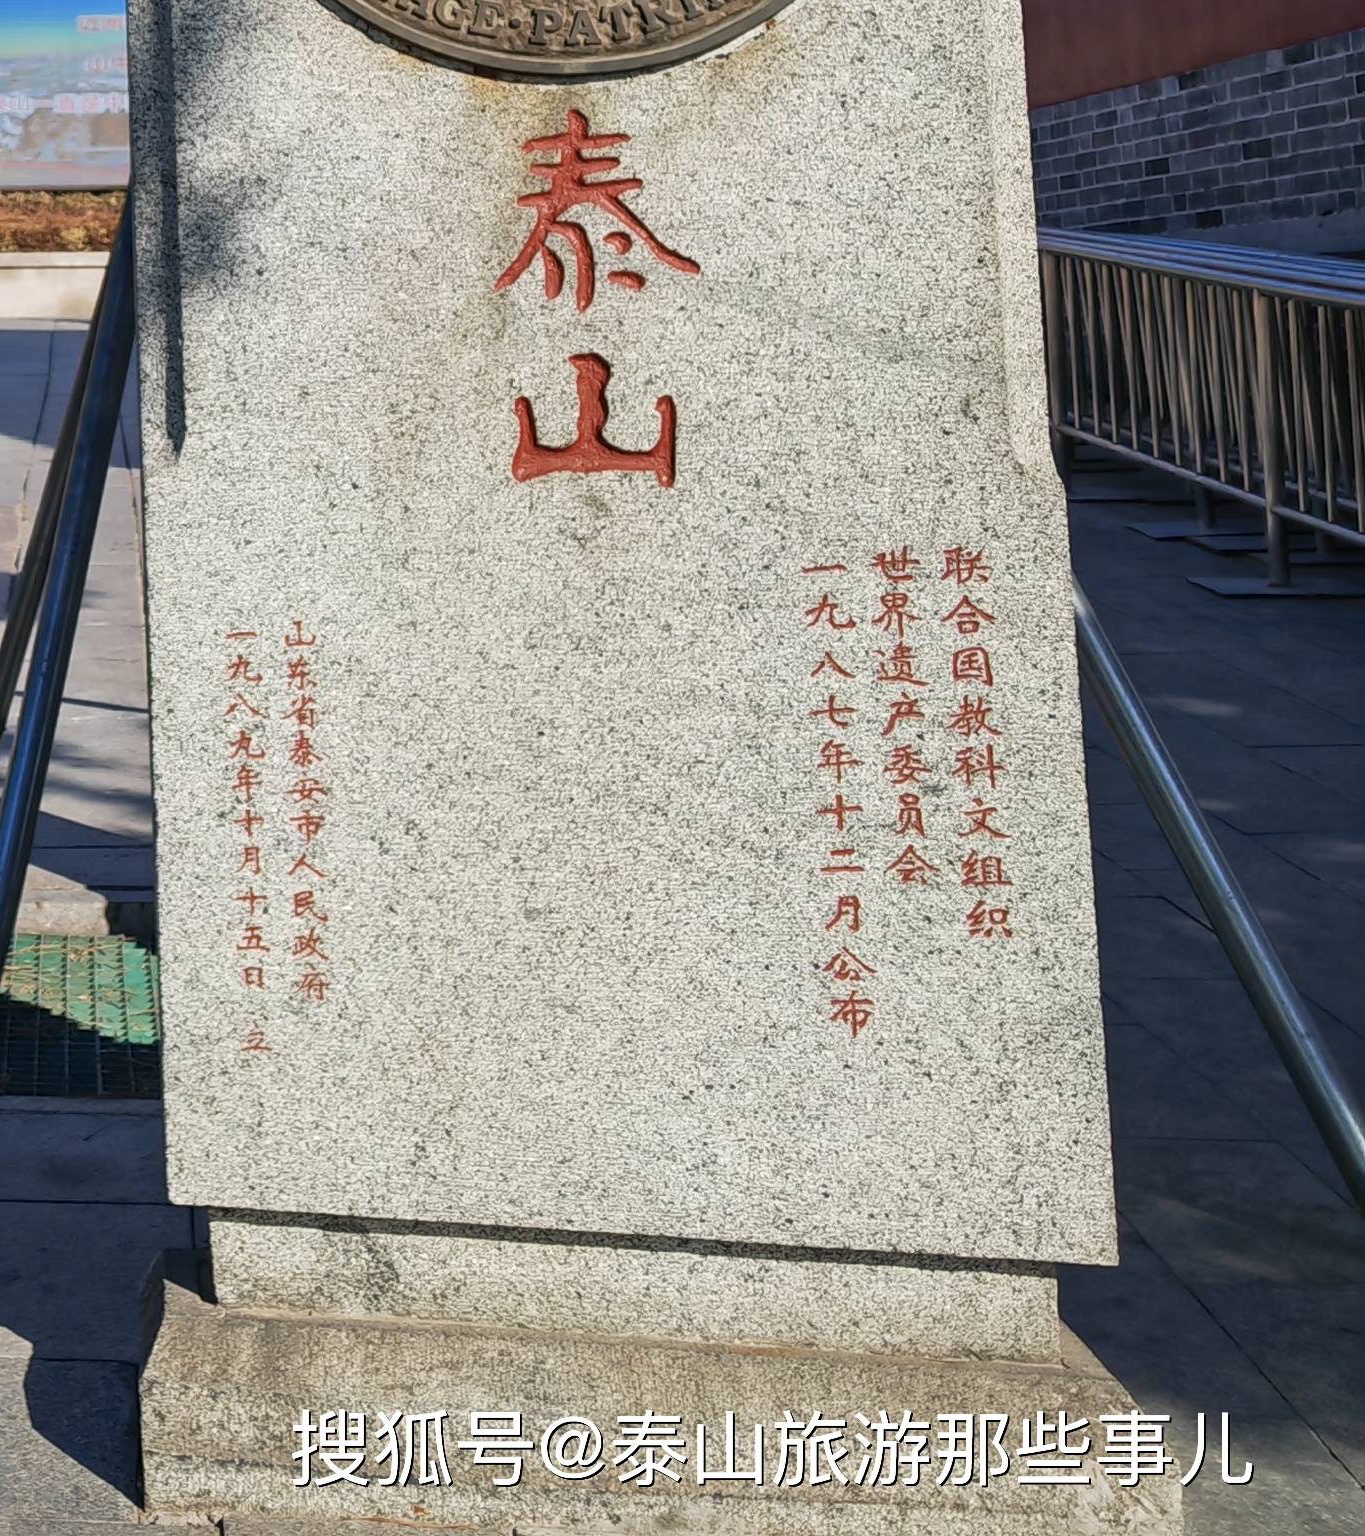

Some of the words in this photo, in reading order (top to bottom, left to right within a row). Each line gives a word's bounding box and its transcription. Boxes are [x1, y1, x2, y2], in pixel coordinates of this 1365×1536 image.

[494, 109, 701, 489] 泰山
[224, 629, 269, 990] 一九八九年十月十五日
[281, 620, 329, 1003] 山东省泰安市人民政府
[801, 560, 876, 1038] 一九八七年十二月公布
[872, 545, 940, 886] 世界遗产委员会
[941, 545, 1013, 939] 联合国教科文组织
